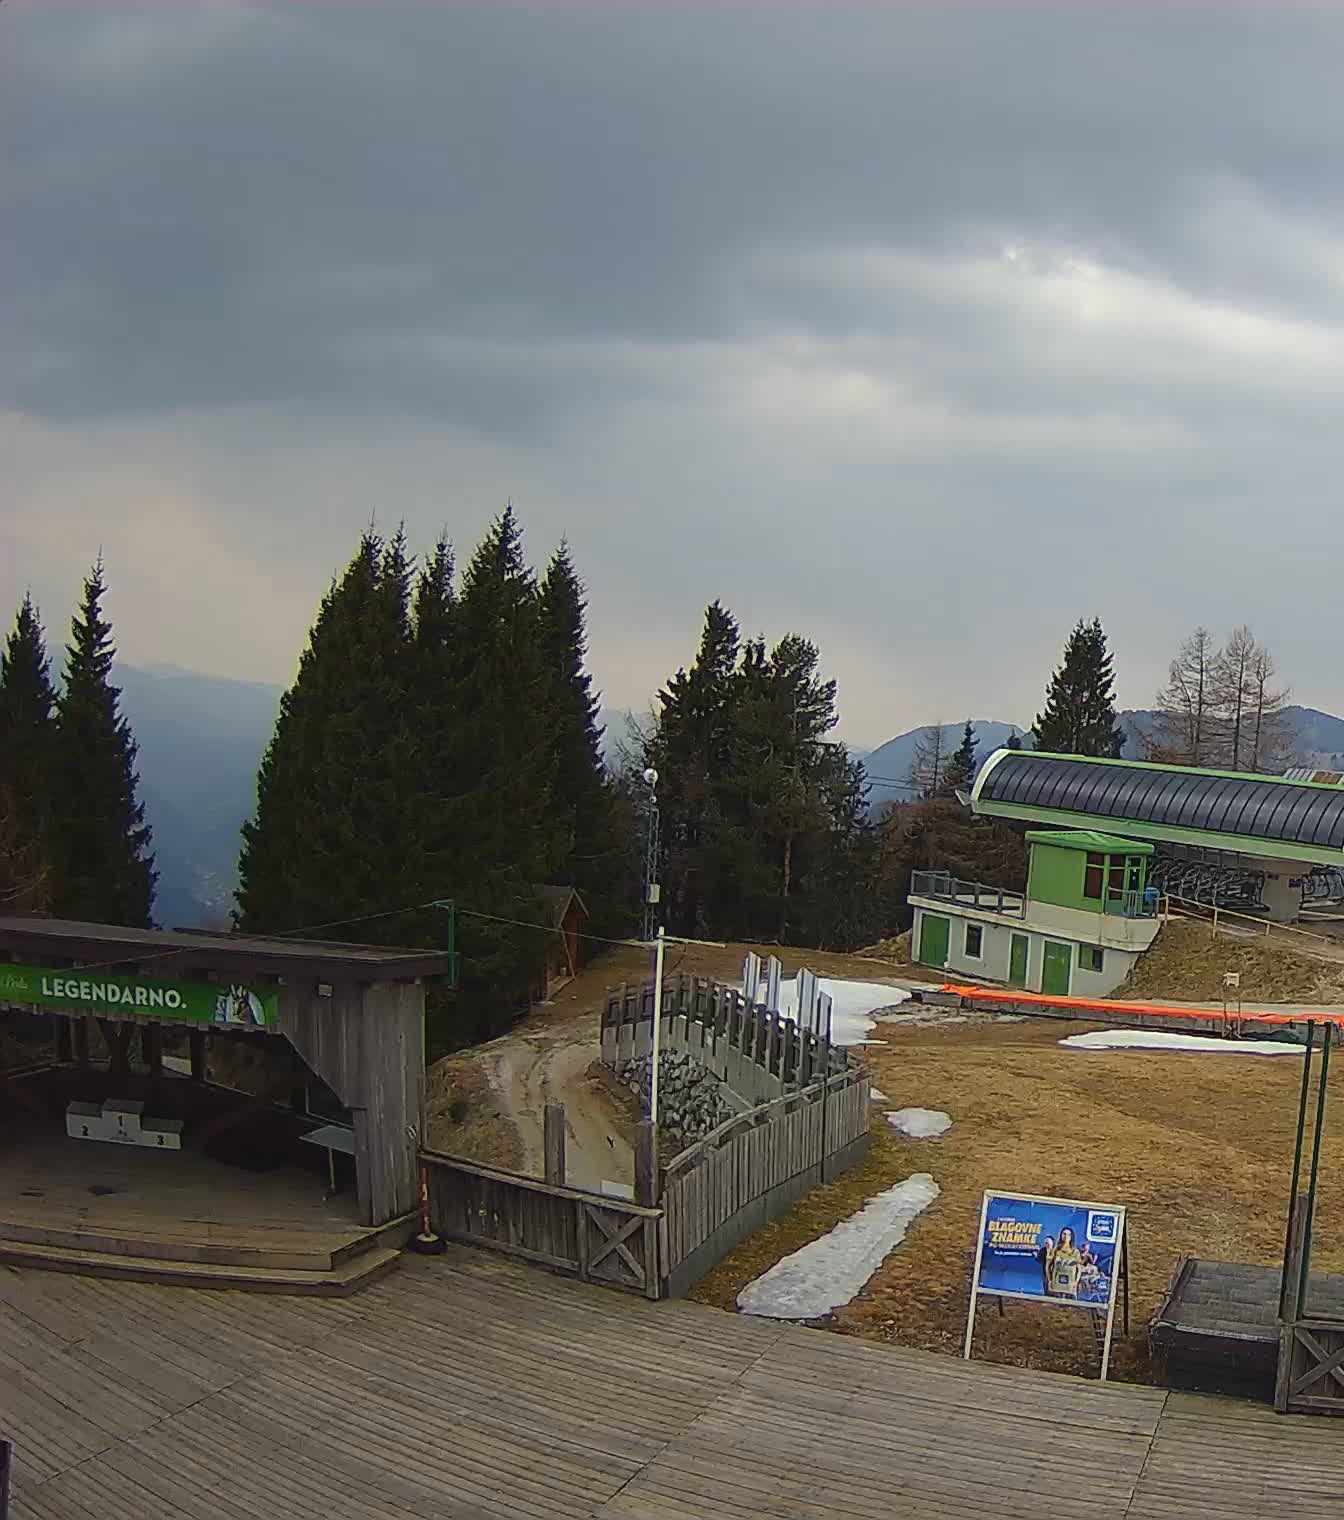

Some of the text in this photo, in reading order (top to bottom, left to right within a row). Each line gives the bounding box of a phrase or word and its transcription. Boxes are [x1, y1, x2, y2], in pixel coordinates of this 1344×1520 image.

[41, 976, 188, 1009] LEGENDARNO.
[82, 1125, 89, 1137] 2
[988, 1220, 1042, 1234] BLAGOVNE
[991, 1231, 1037, 1244] ZNAMKE
